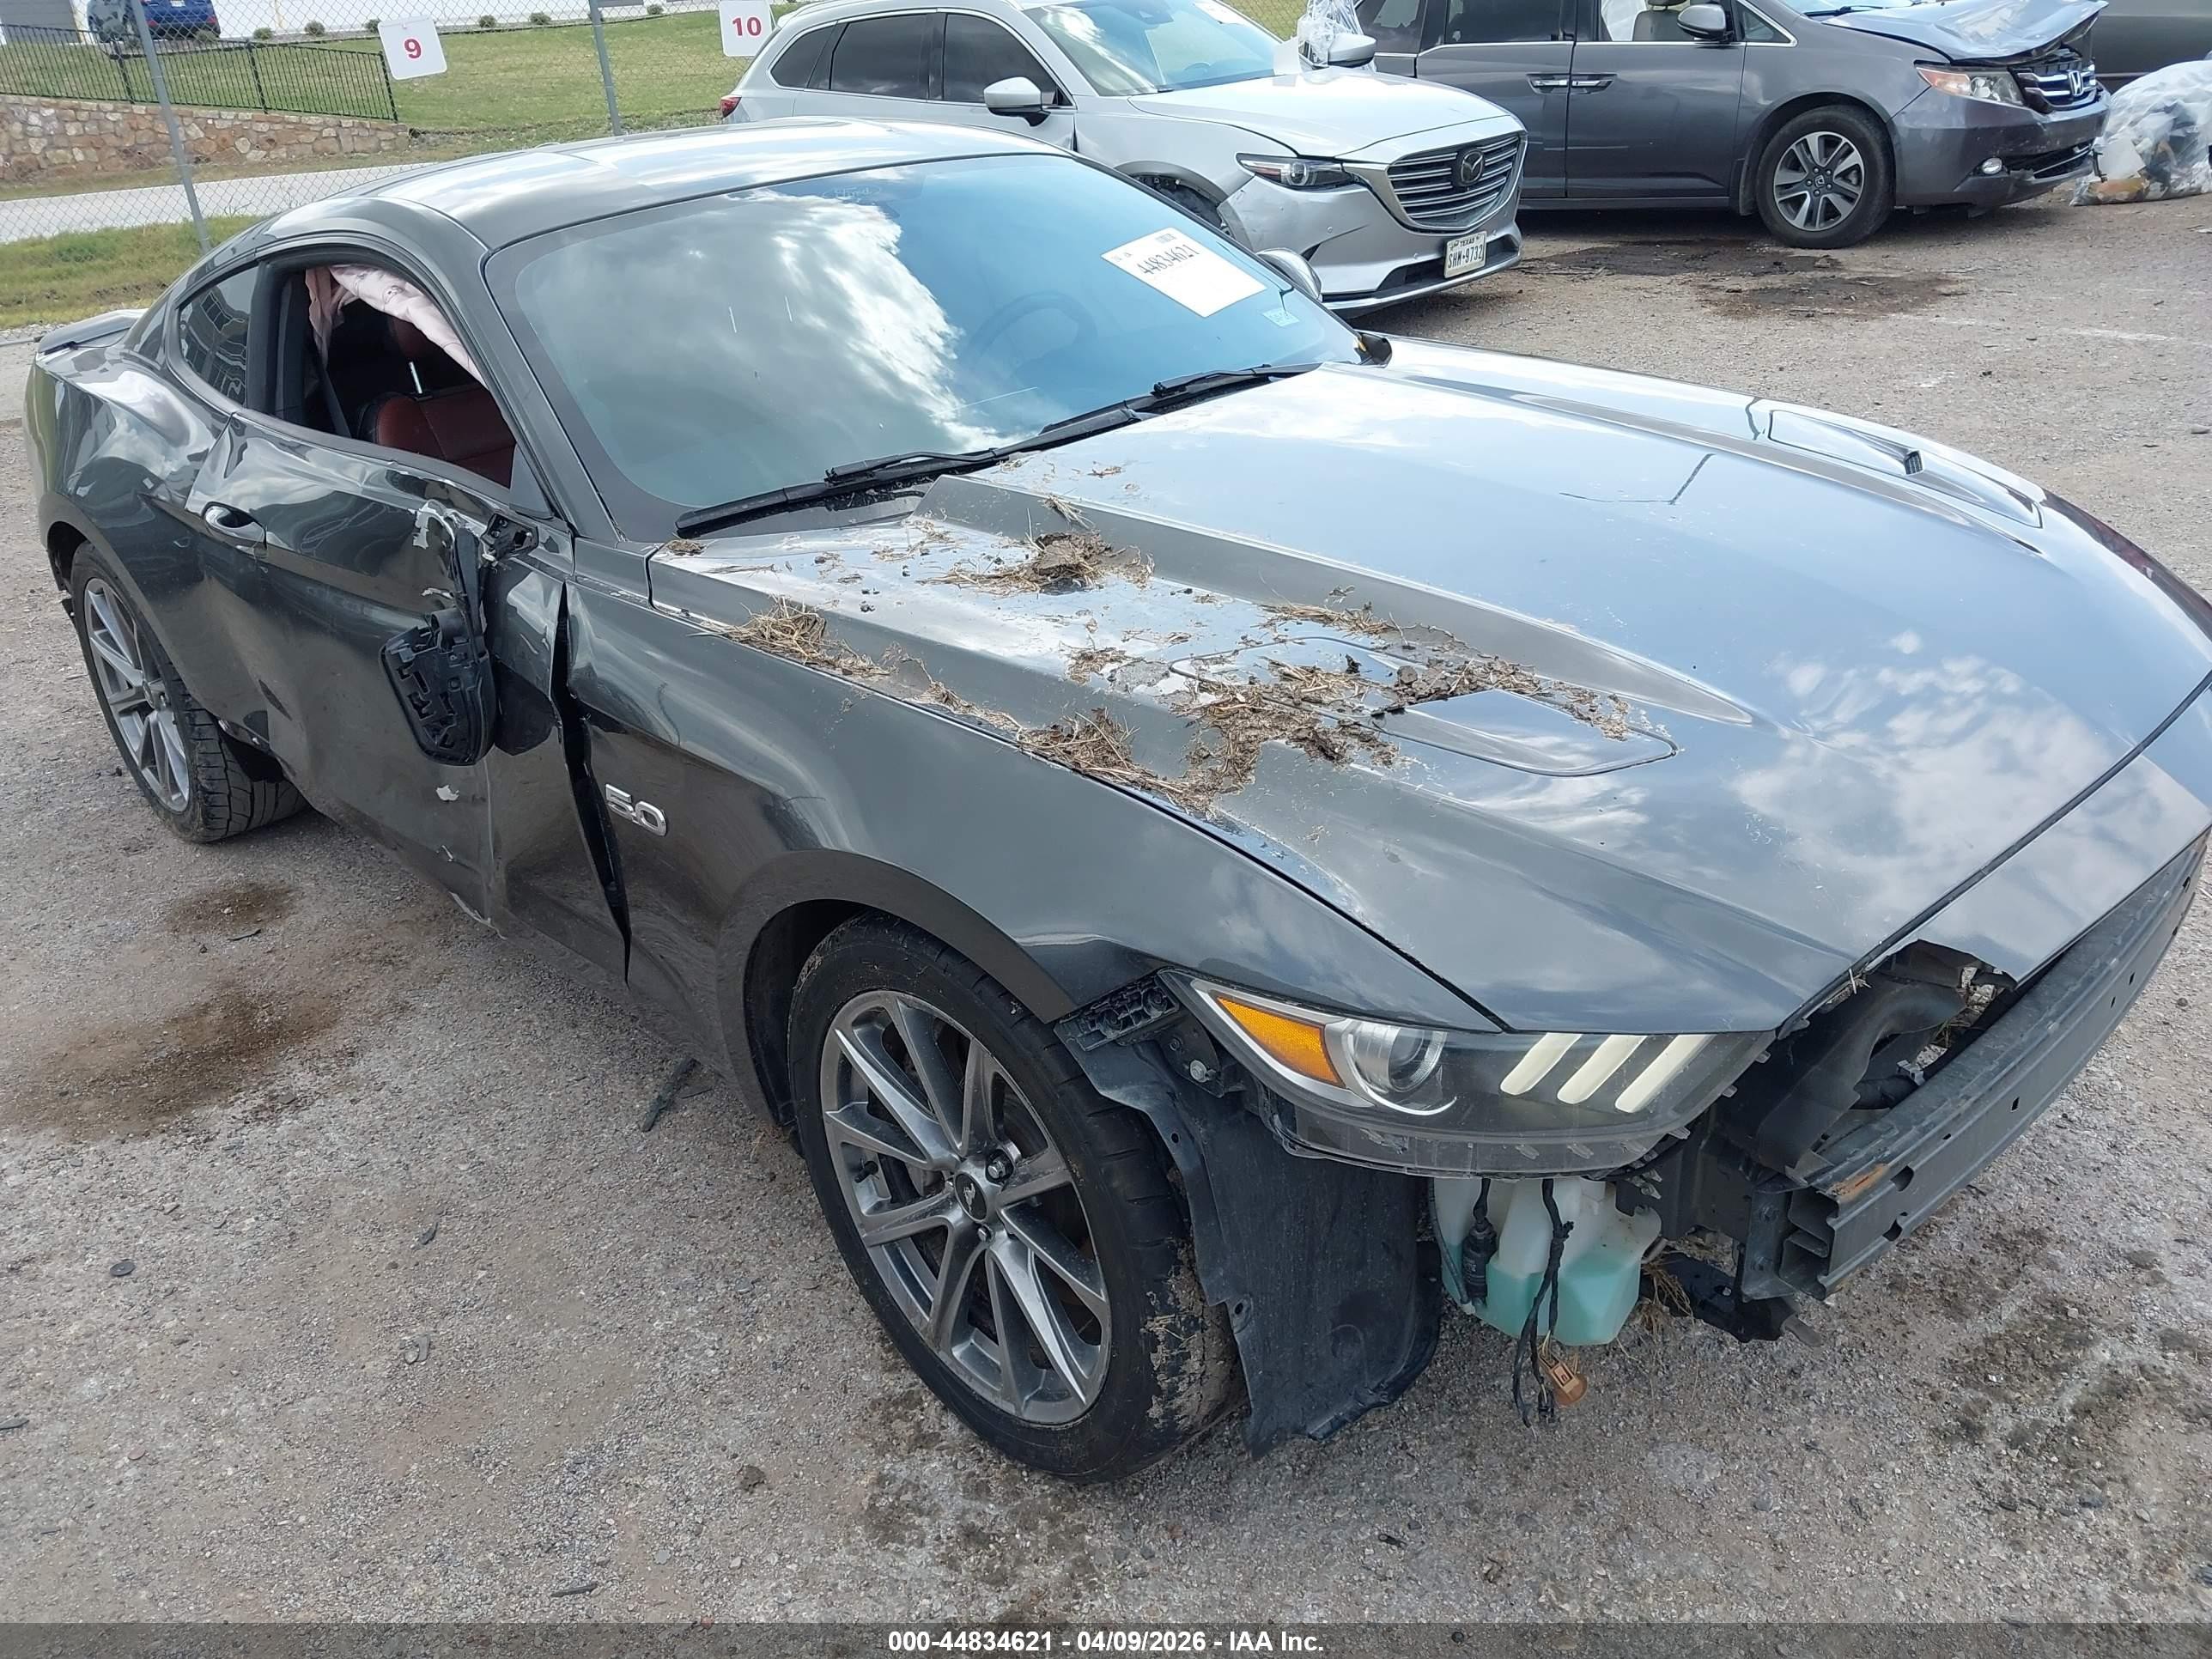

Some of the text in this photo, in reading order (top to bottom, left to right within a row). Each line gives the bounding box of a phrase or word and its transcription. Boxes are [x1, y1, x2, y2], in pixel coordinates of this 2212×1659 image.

[732, 17, 762, 36] 10
[404, 39, 422, 59] 9
[1460, 238, 1474, 247] TEXAS
[1136, 244, 1200, 274] 44834621
[605, 783, 667, 836] 5.0
